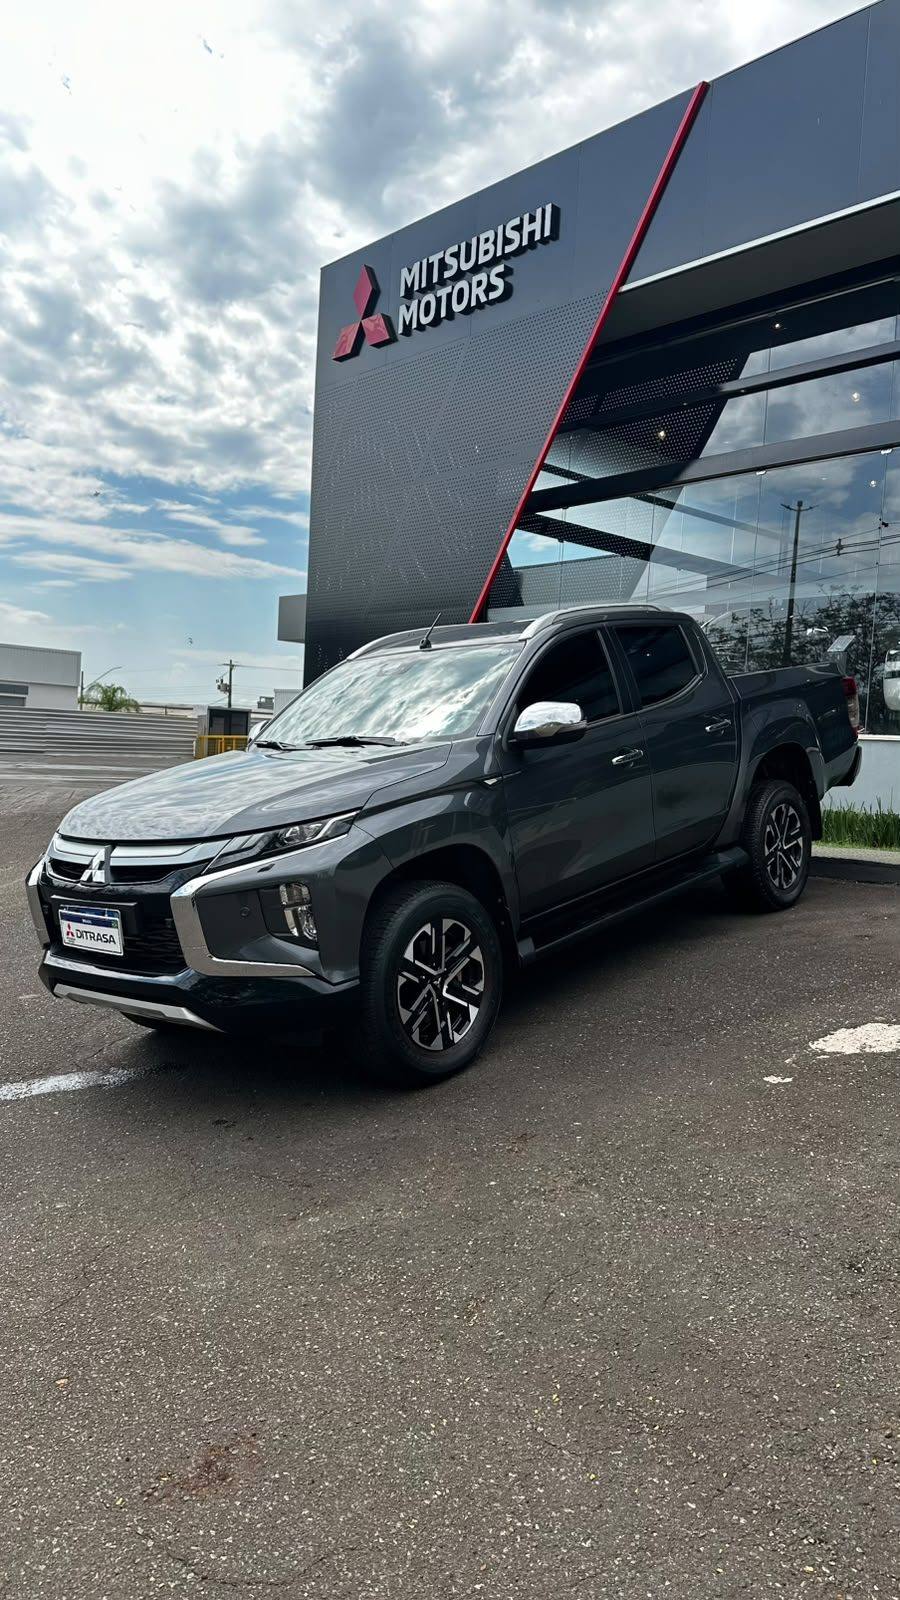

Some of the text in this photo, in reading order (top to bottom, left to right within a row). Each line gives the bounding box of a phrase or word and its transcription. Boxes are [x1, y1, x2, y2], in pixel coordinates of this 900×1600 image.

[400, 202, 556, 298] MITSUBISHI
[398, 263, 507, 335] MOTORS
[75, 929, 116, 944] DITRASA
